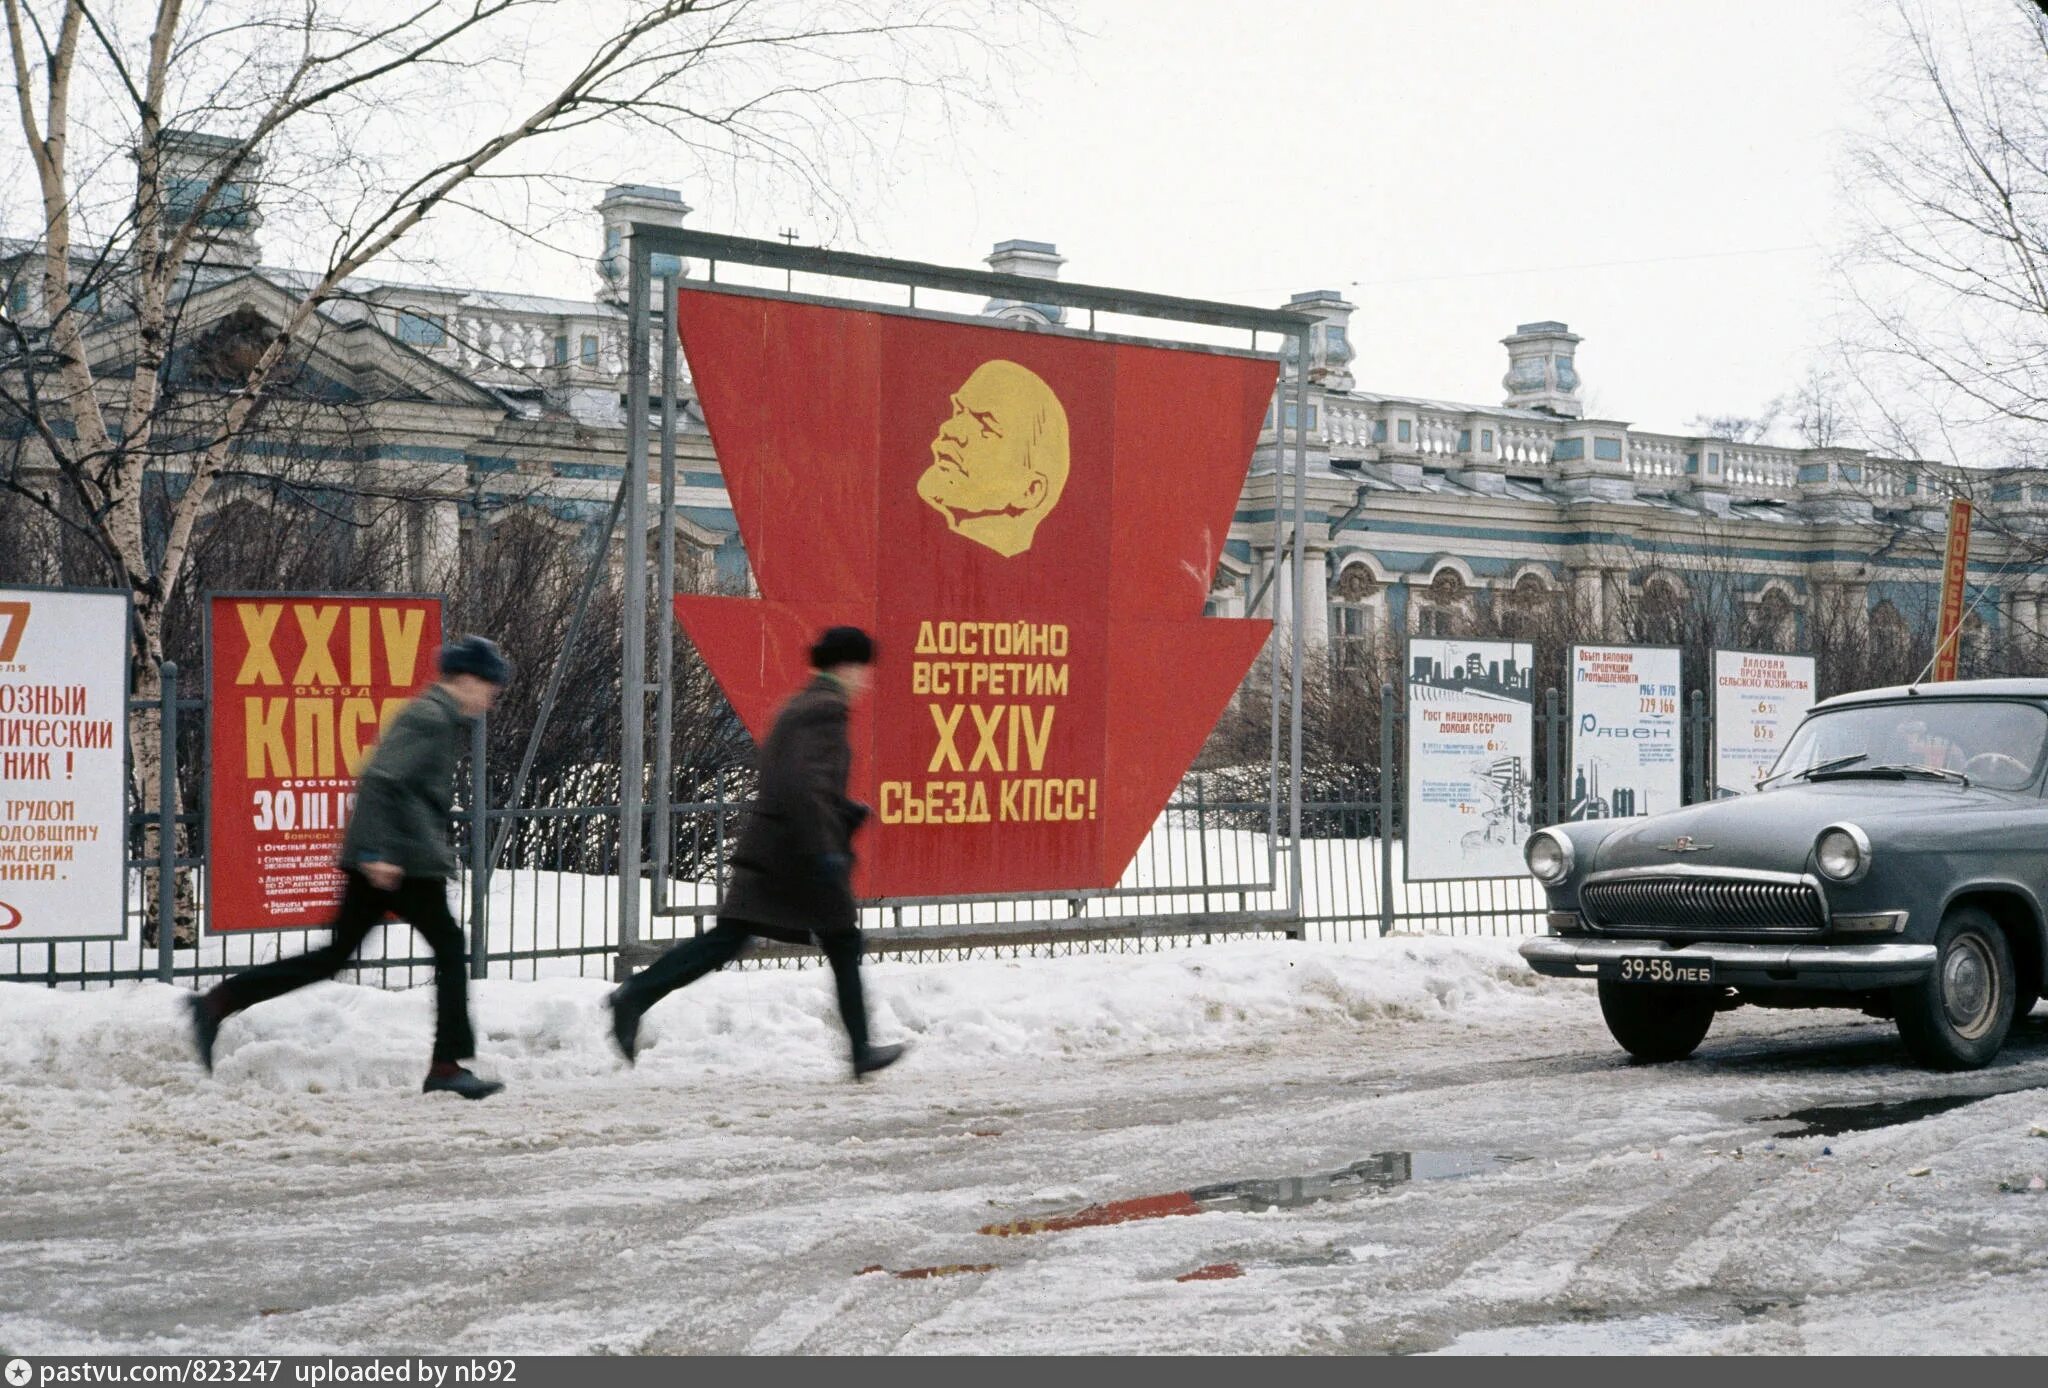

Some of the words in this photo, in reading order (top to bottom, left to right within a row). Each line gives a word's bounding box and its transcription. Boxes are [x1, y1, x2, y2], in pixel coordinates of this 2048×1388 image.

[235, 604, 426, 687] XXIV
[914, 620, 1069, 657] ДОСТОЙНО
[912, 661, 1069, 696] ВСТРЕТИМ
[927, 704, 1055, 773] XXIV
[0, 752, 51, 780] НИК
[6, 800, 74, 821] ТРУДОМ
[880, 780, 991, 824] СЪЕЗД
[0, 845, 73, 862] ЖДЕНИЯ
